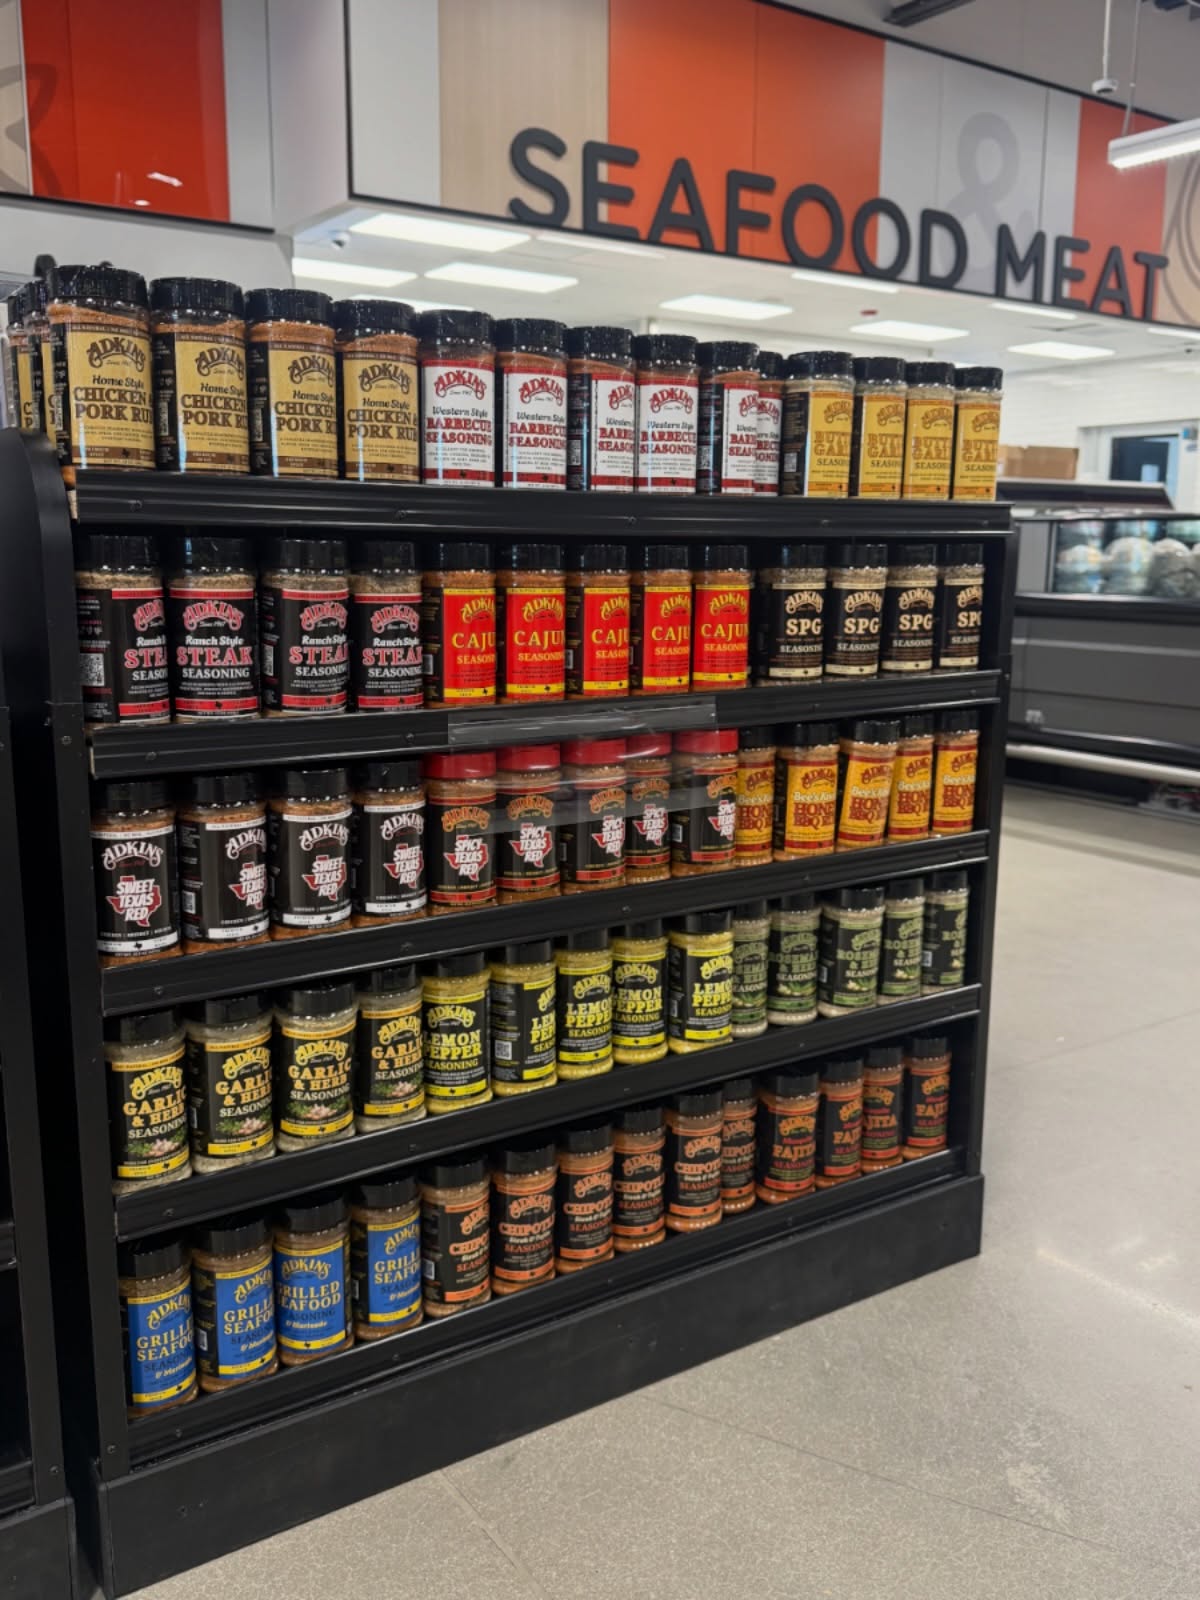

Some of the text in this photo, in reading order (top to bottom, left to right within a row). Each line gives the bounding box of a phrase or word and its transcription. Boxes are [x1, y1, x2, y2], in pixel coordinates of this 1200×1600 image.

[509, 127, 1168, 322] SEAFOOD MEAT
[92, 375, 125, 390] Home
[200, 382, 229, 395] Home
[434, 370, 487, 401] ADKINS
[73, 386, 146, 406] CHICKEN
[363, 397, 390, 408] Home
[75, 403, 152, 425] PORK RU
[182, 410, 232, 428] PORK
[347, 409, 412, 425] CHICKEN
[432, 406, 472, 417] Western
[275, 416, 322, 434] PORK
[348, 423, 394, 440] PORK
[182, 599, 245, 631] ADKINS
[899, 613, 934, 632] SPG
[701, 623, 749, 642] CAJU
[786, 618, 823, 637] SPG
[844, 617, 880, 635] SPG
[186, 636, 245, 650] Ranch Style
[373, 638, 402, 647] Ranch
[452, 631, 496, 652] CAJU
[513, 629, 565, 651] CAJU
[124, 648, 168, 669] STE
[176, 646, 253, 668] STEAK
[362, 647, 423, 667] STEA
[182, 668, 250, 682] SEASONING
[101, 840, 164, 871] ADKINS
[116, 878, 156, 895] SWEET
[118, 892, 155, 910] TEXAS
[124, 907, 150, 922] RED
[566, 997, 612, 1016] LEMO
[287, 1057, 352, 1080] GARLIC
[378, 1058, 391, 1070] &
[293, 1079, 306, 1091] &
[223, 1094, 236, 1107] &
[131, 1115, 149, 1128] &
[283, 1280, 340, 1300] RILLED
